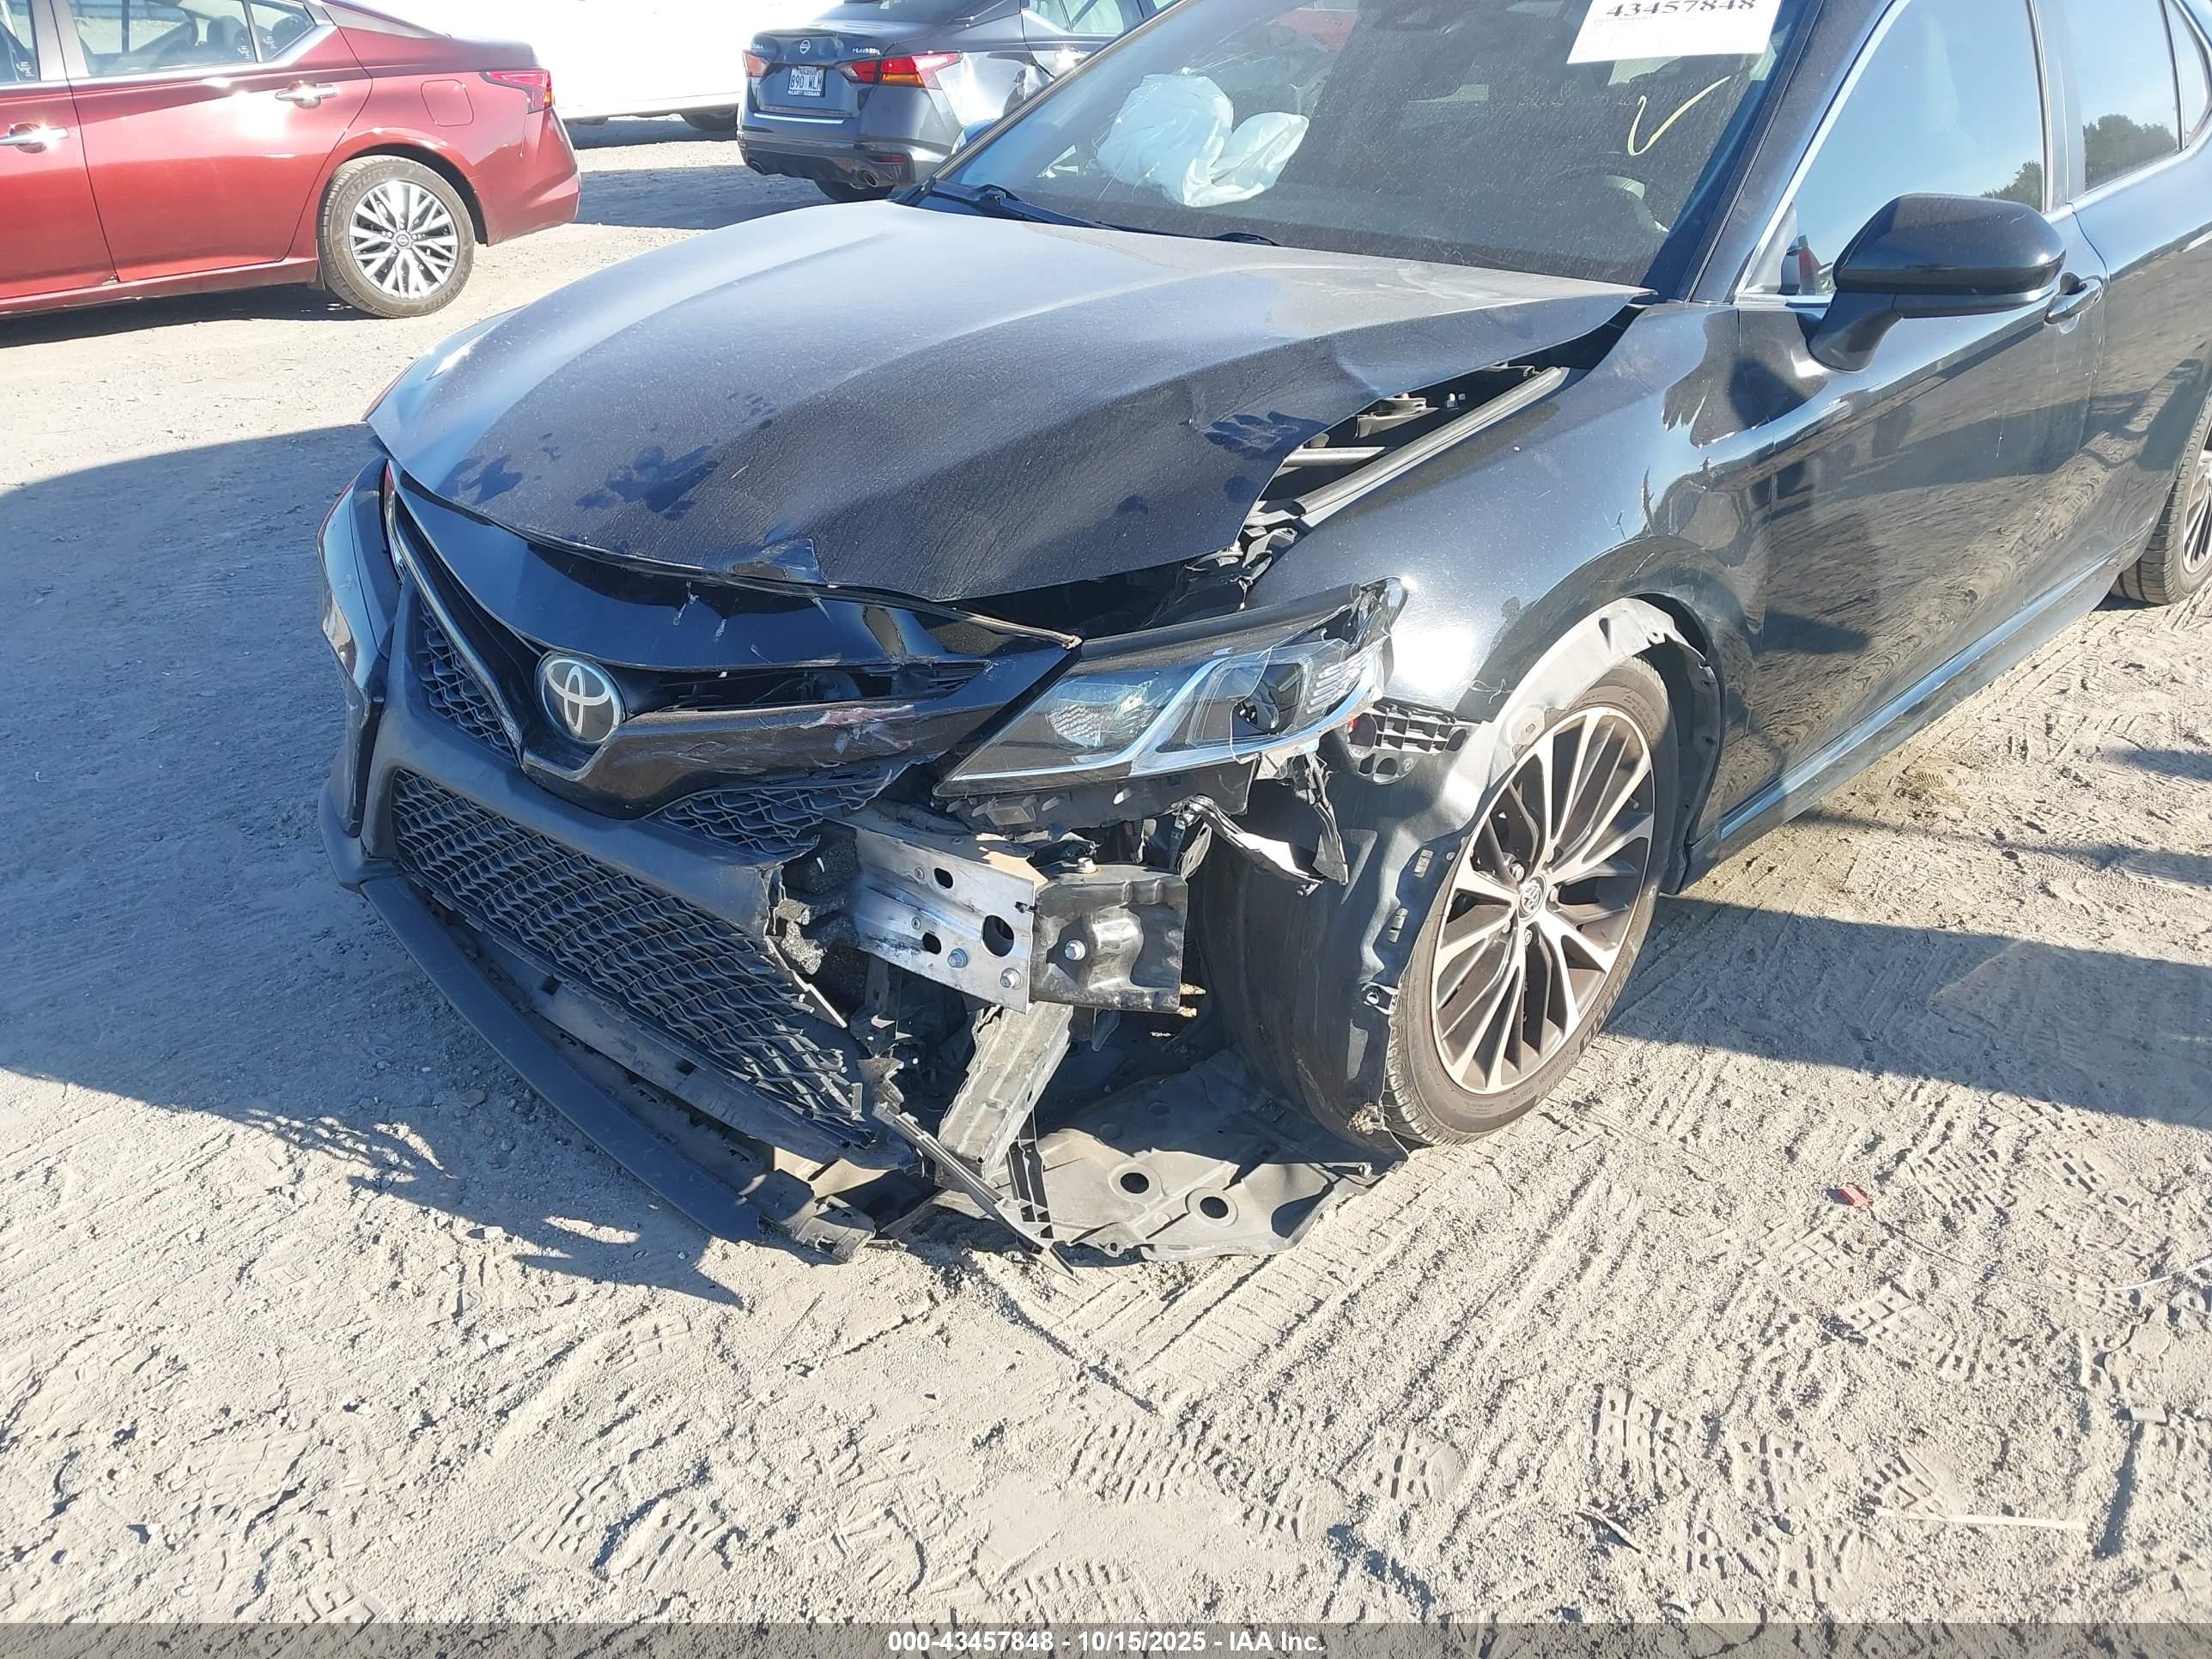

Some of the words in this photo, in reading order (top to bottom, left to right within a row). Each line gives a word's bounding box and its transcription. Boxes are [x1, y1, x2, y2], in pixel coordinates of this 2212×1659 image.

[1605, 0, 1757, 17] 43457848
[790, 75, 805, 88] 890
[808, 75, 823, 90] WLM
